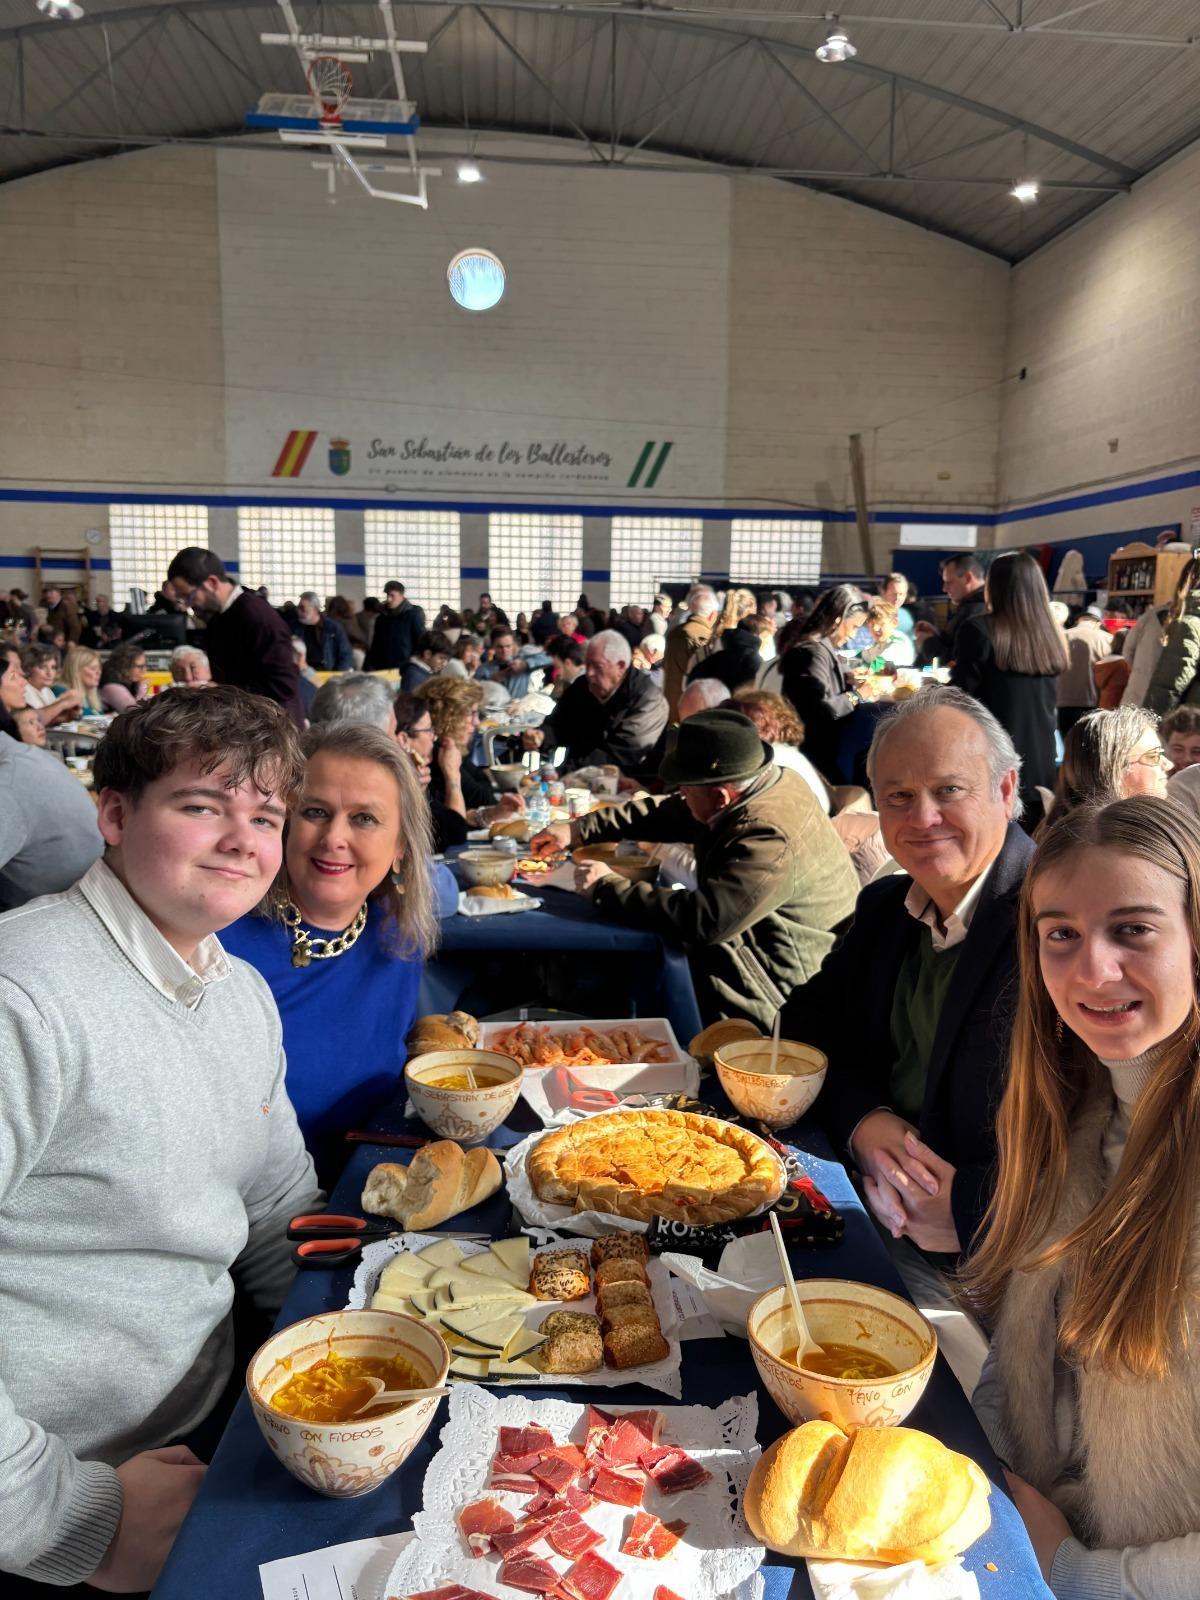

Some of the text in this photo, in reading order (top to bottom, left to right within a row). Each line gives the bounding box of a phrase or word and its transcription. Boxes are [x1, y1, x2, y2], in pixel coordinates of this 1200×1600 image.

[367, 438, 396, 459] San
[475, 443, 494, 462] de
[498, 441, 521, 465] los
[527, 442, 612, 467] Ballesteros
[300, 1429, 323, 1444] CON
